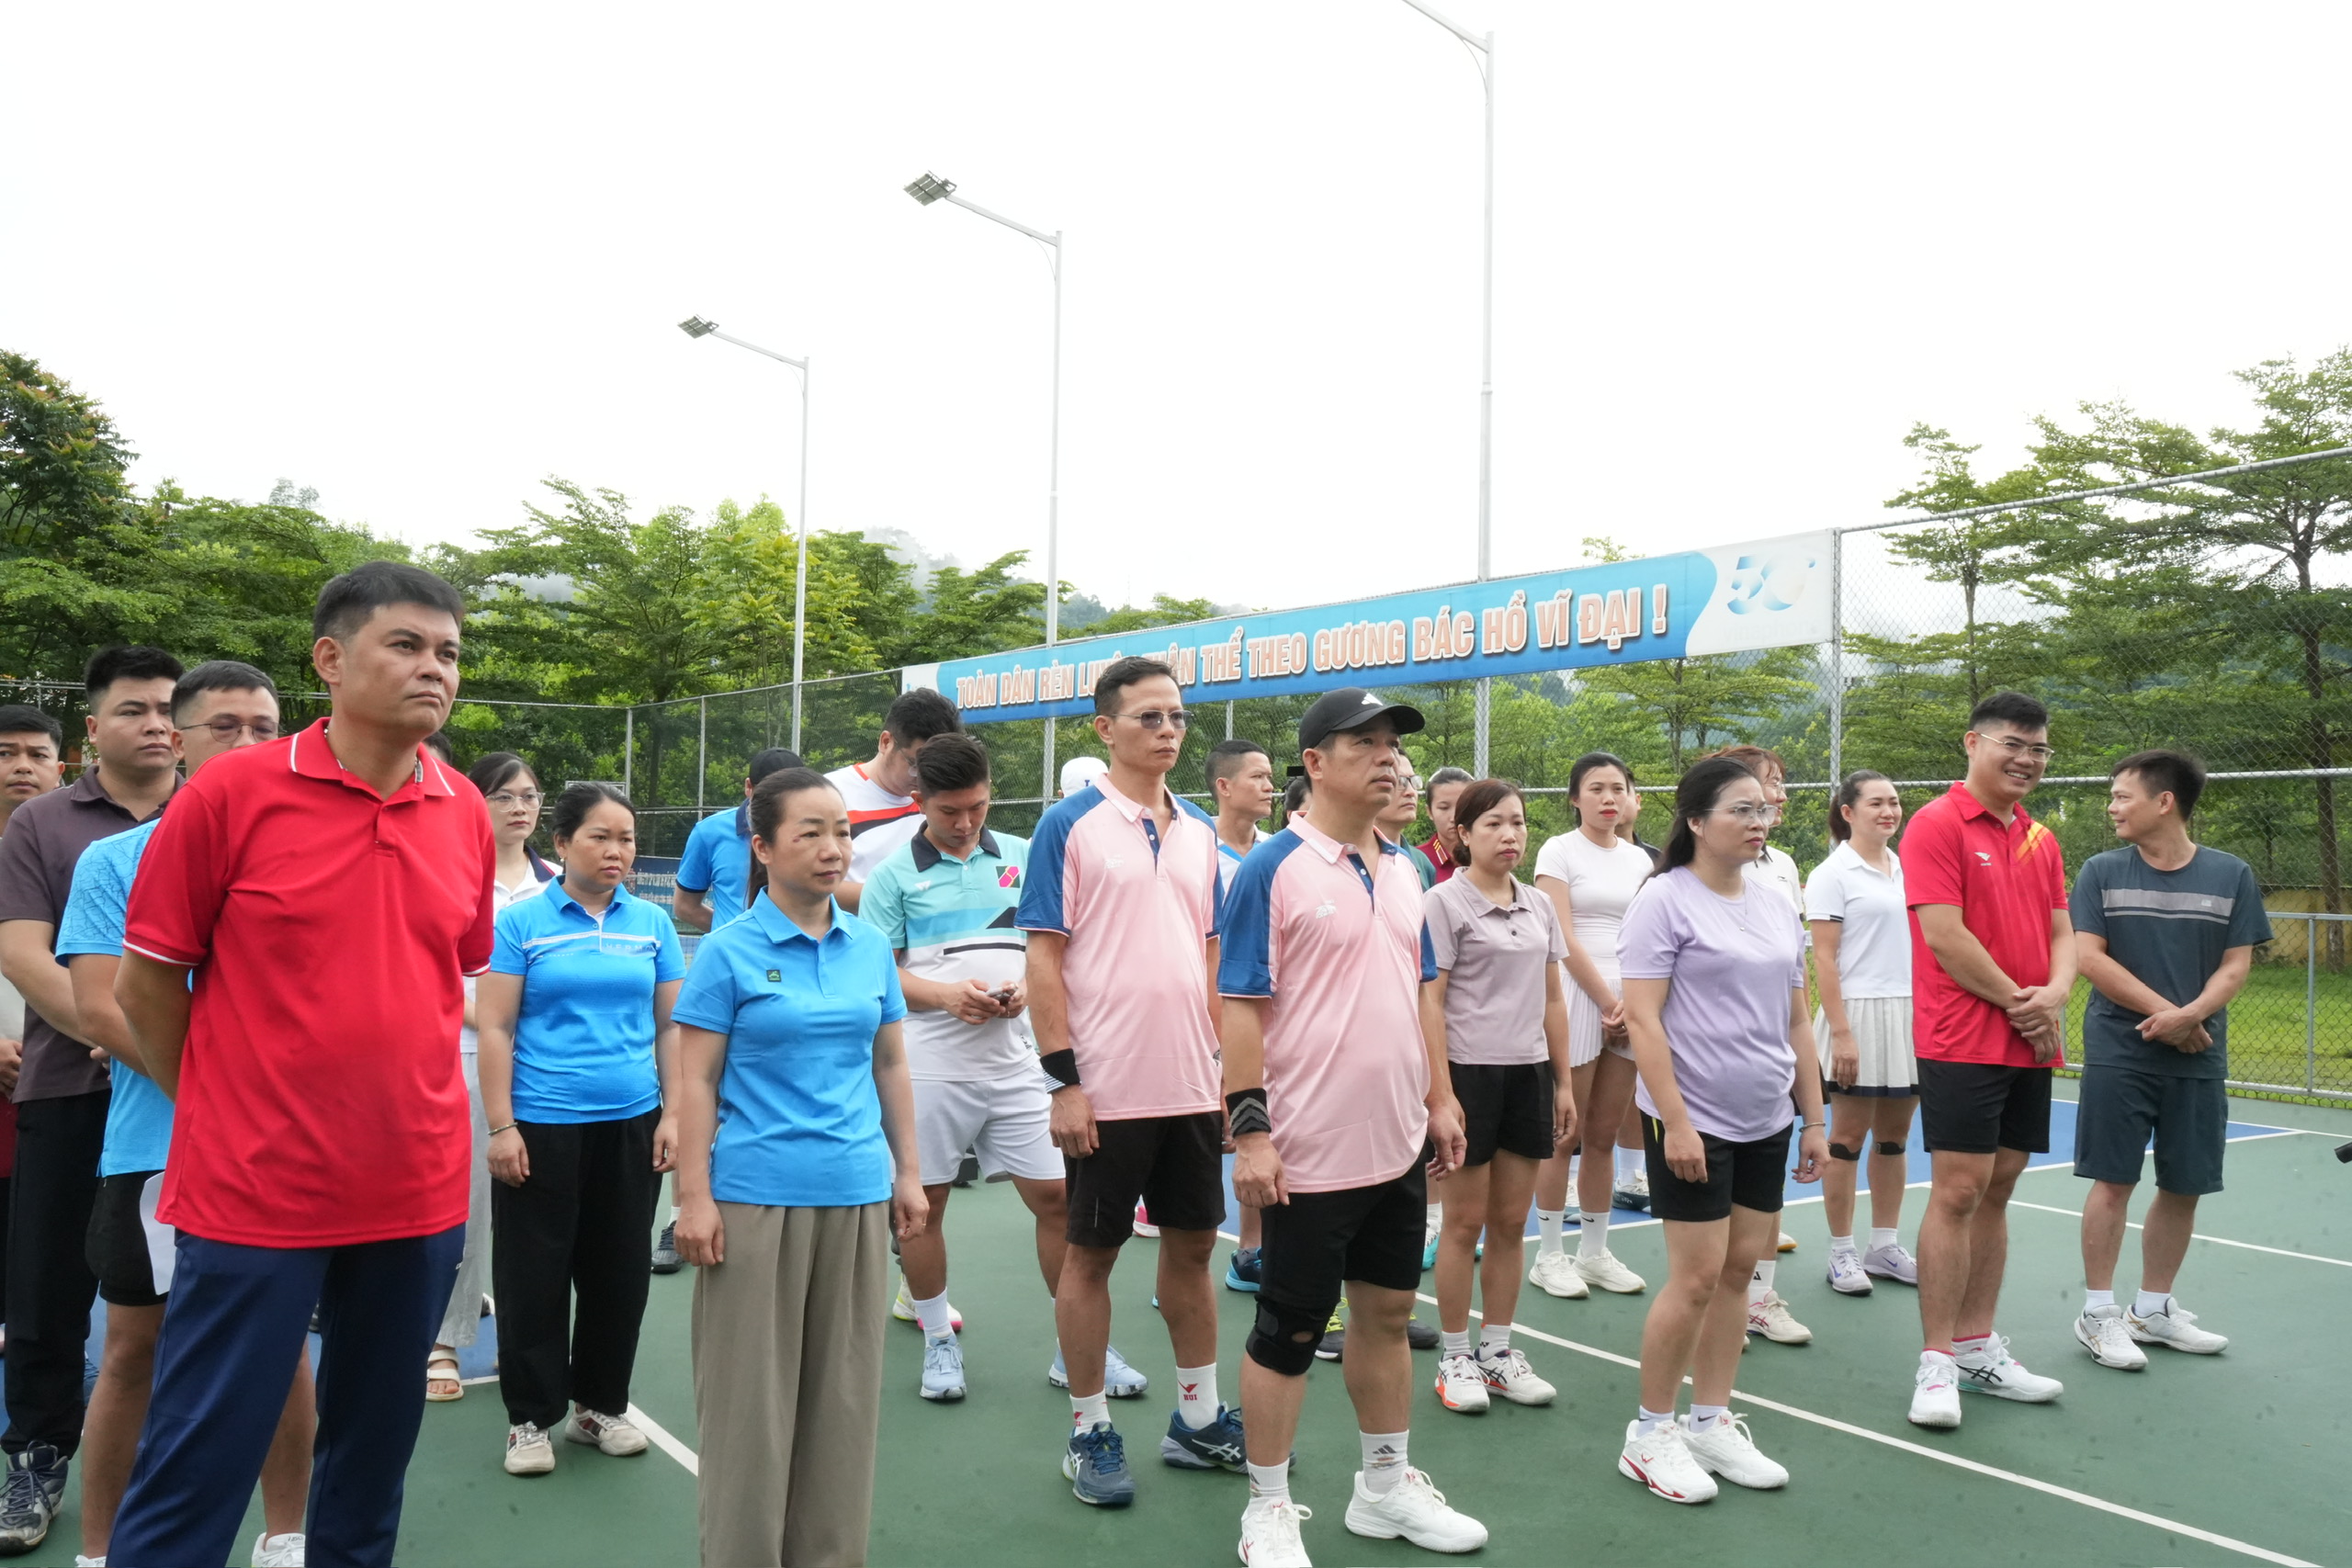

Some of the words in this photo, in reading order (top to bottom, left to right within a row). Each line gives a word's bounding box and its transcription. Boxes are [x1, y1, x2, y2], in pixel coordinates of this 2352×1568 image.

[956, 669, 997, 709] TOÀN
[1000, 664, 1035, 705] DÂN
[1038, 660, 1075, 701] RÈN
[1141, 642, 1196, 685] ÂN
[1200, 626, 1244, 682] THỂ
[1247, 631, 1307, 678] THEO
[1313, 620, 1407, 671] GƯƠNG
[1412, 605, 1475, 661] BÁC
[1482, 589, 1528, 654] HỒ
[1534, 589, 1572, 648] VĨ
[1577, 587, 1641, 649] ĐẠI
[1653, 583, 1667, 635] !
